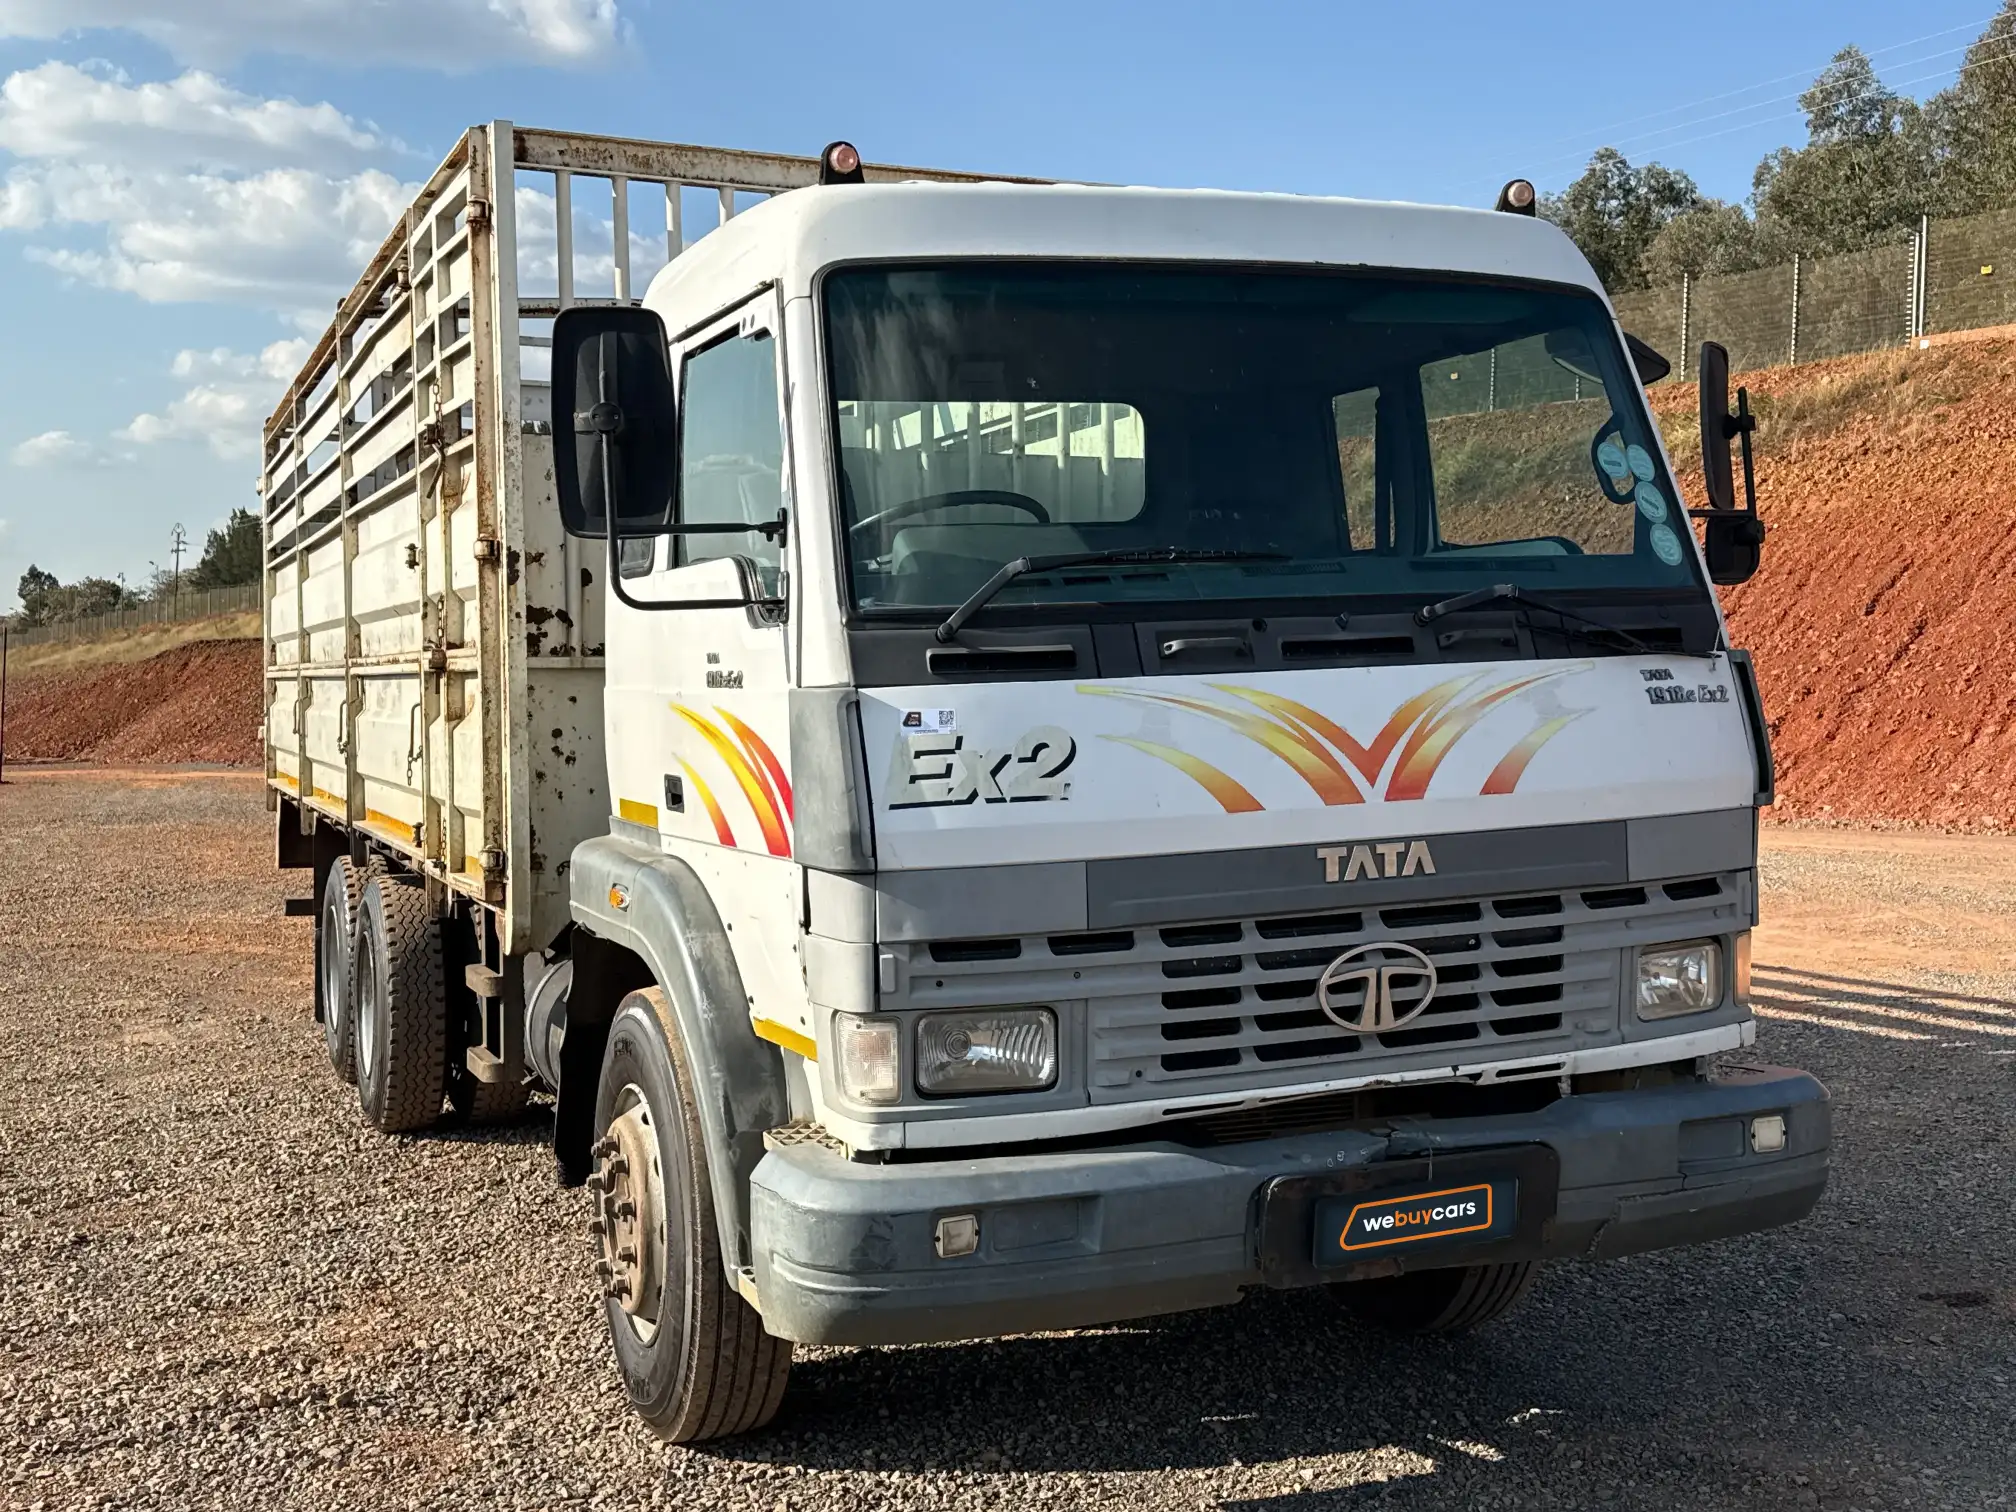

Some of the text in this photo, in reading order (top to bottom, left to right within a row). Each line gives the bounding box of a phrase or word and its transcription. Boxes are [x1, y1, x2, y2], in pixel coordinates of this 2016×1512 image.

[882, 725, 1077, 811] Ex2
[1316, 840, 1437, 883] TATA
[1362, 1201, 1476, 1232] webuycars
